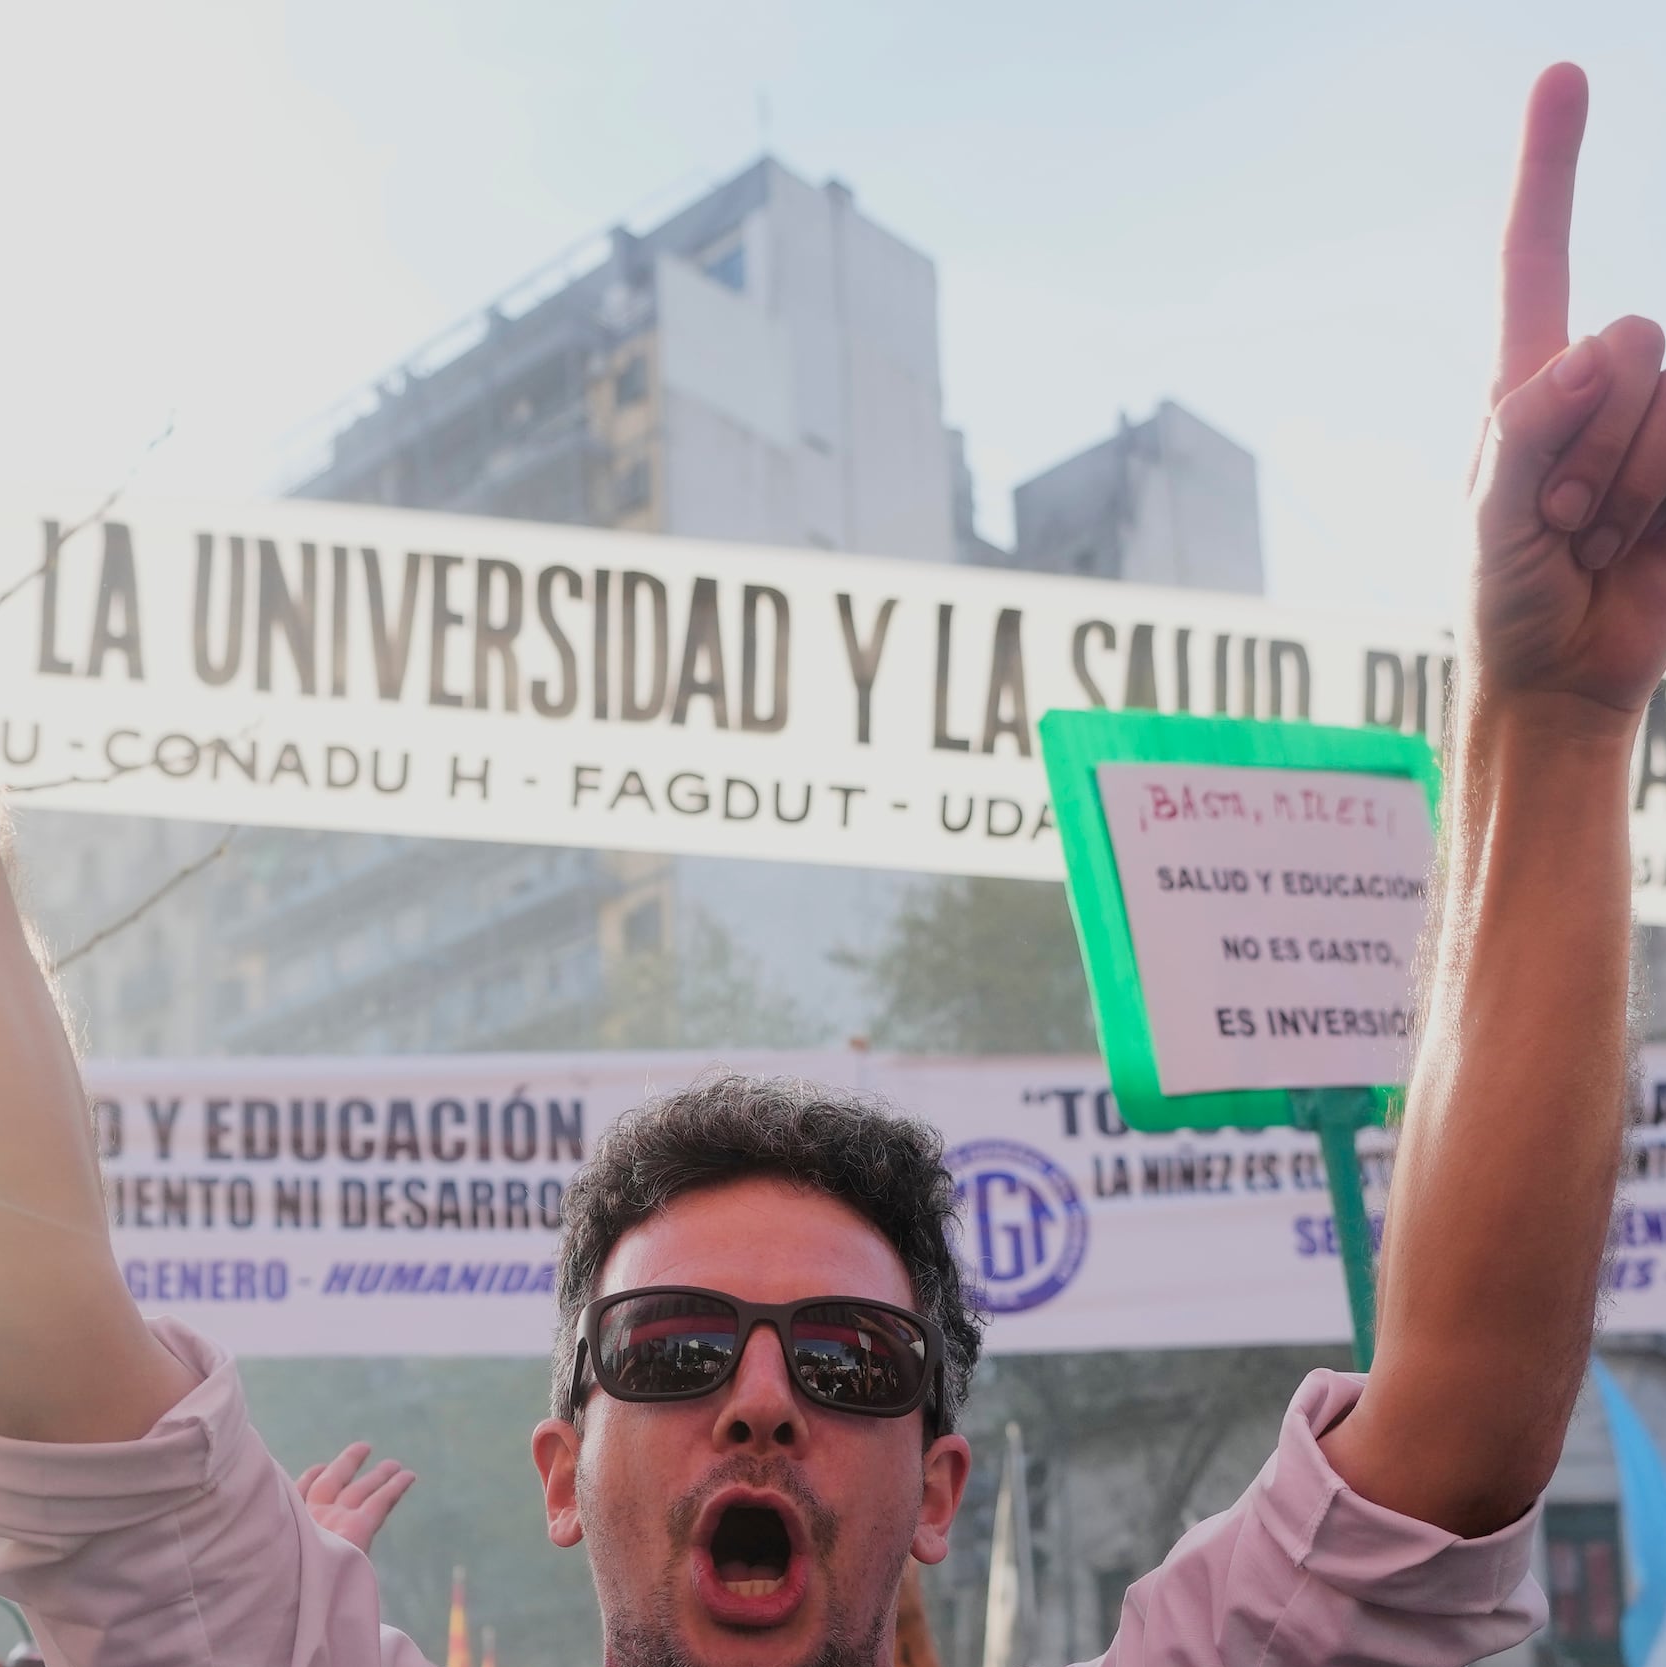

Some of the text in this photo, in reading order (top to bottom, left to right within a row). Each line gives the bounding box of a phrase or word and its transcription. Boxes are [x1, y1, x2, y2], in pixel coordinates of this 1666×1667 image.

[37, 518, 145, 681] LA
[192, 532, 791, 735] UNIVERSIDAD
[836, 592, 900, 746] Y
[932, 603, 1033, 758] LA
[104, 729, 410, 795] CONADU
[450, 757, 490, 801] H
[572, 764, 866, 829] FAGDUT
[1157, 866, 1249, 894] SALUD
[1259, 870, 1274, 894] Y
[1222, 936, 1404, 969] NO ES GASTO,
[1216, 1007, 1414, 1037] ES INVERSIÓ
[150, 1096, 185, 1162] Y
[206, 1083, 585, 1162] EDUCACIÓN
[1096, 1153, 1130, 1199] LA
[1243, 1152, 1280, 1192] ES
[274, 1177, 323, 1232] NI
[340, 1177, 563, 1232] DESARRO
[323, 1261, 555, 1296] HUMANIDA
